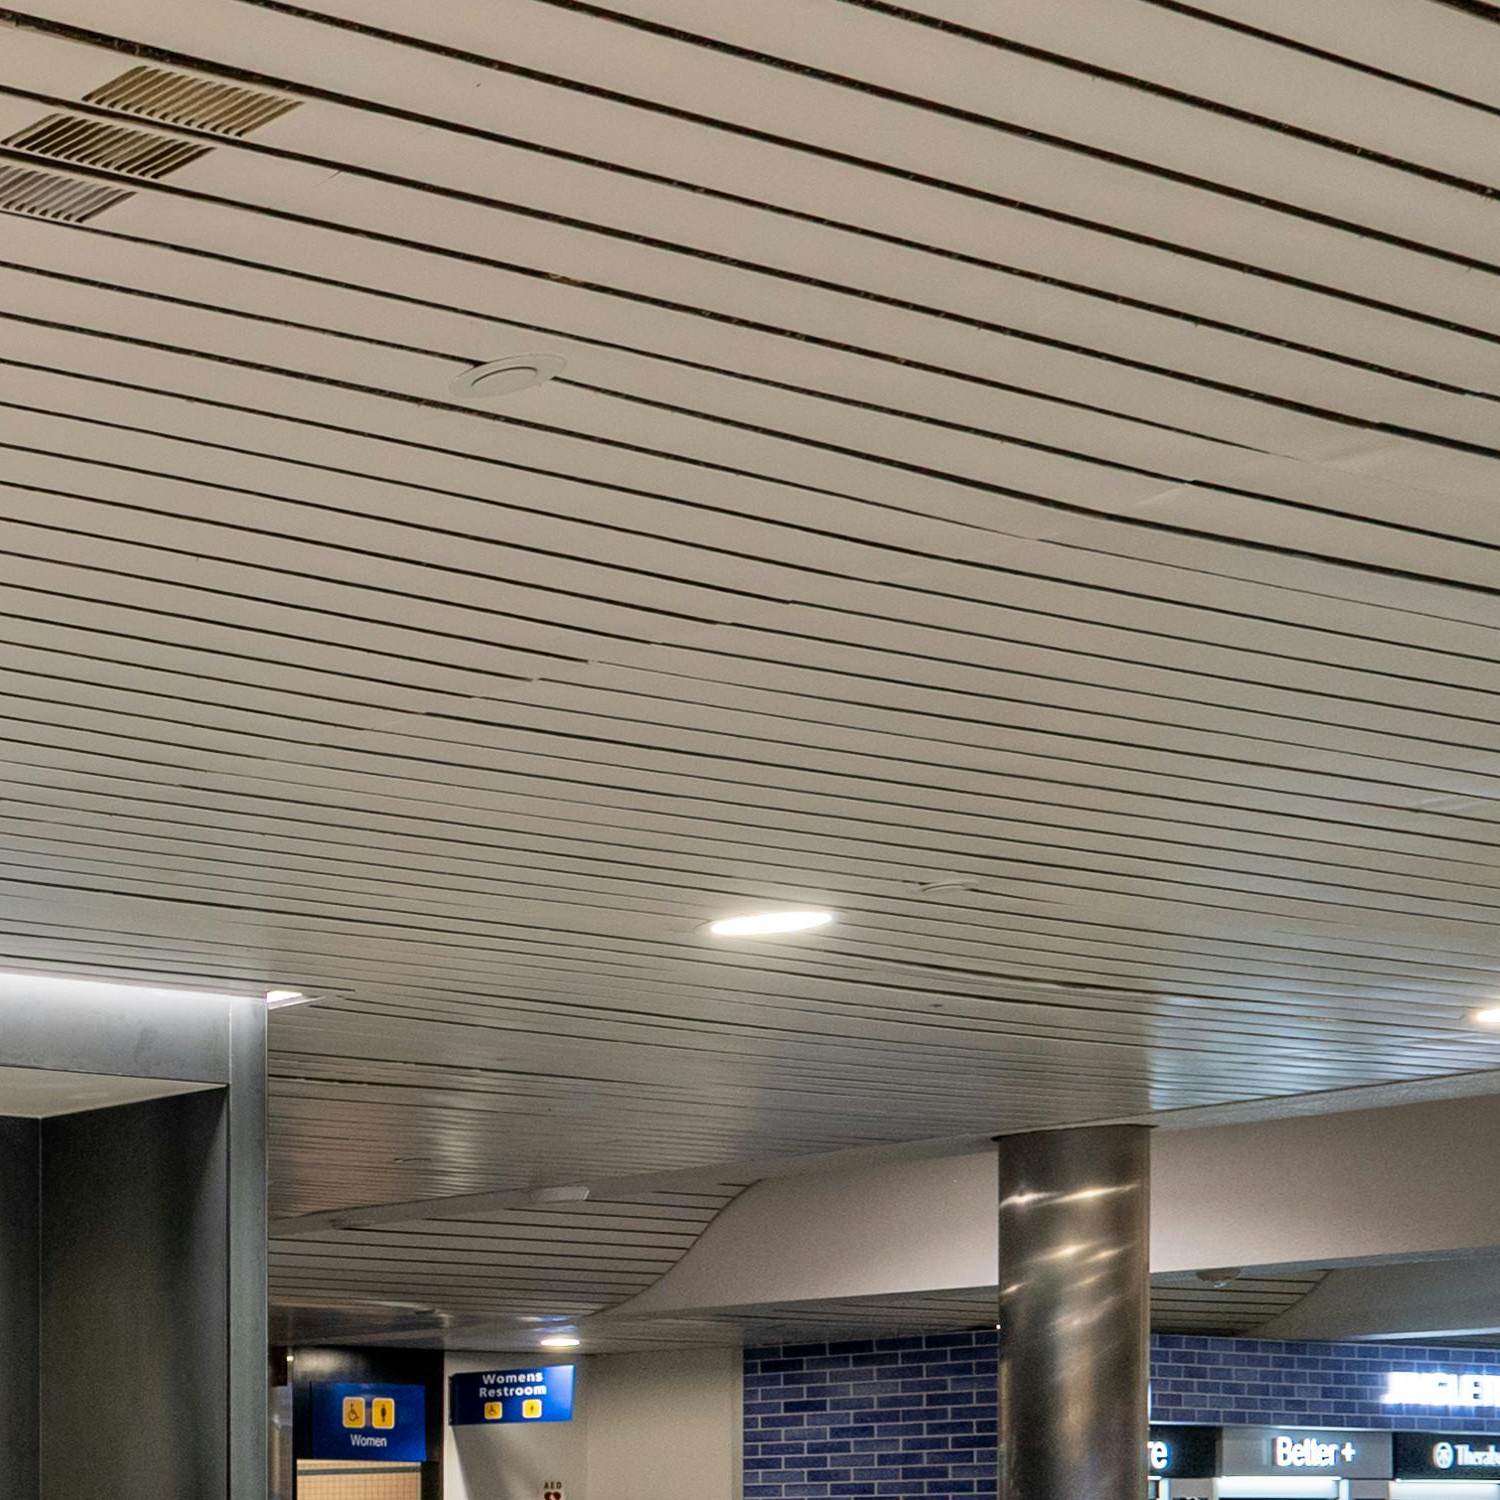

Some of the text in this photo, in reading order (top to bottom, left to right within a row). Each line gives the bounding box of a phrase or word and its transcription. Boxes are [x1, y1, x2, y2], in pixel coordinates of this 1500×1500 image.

[482, 1371, 543, 1385] Womens
[479, 1384, 547, 1398] Restroom
[350, 1433, 388, 1448] Women
[1276, 1436, 1339, 1466] Better
